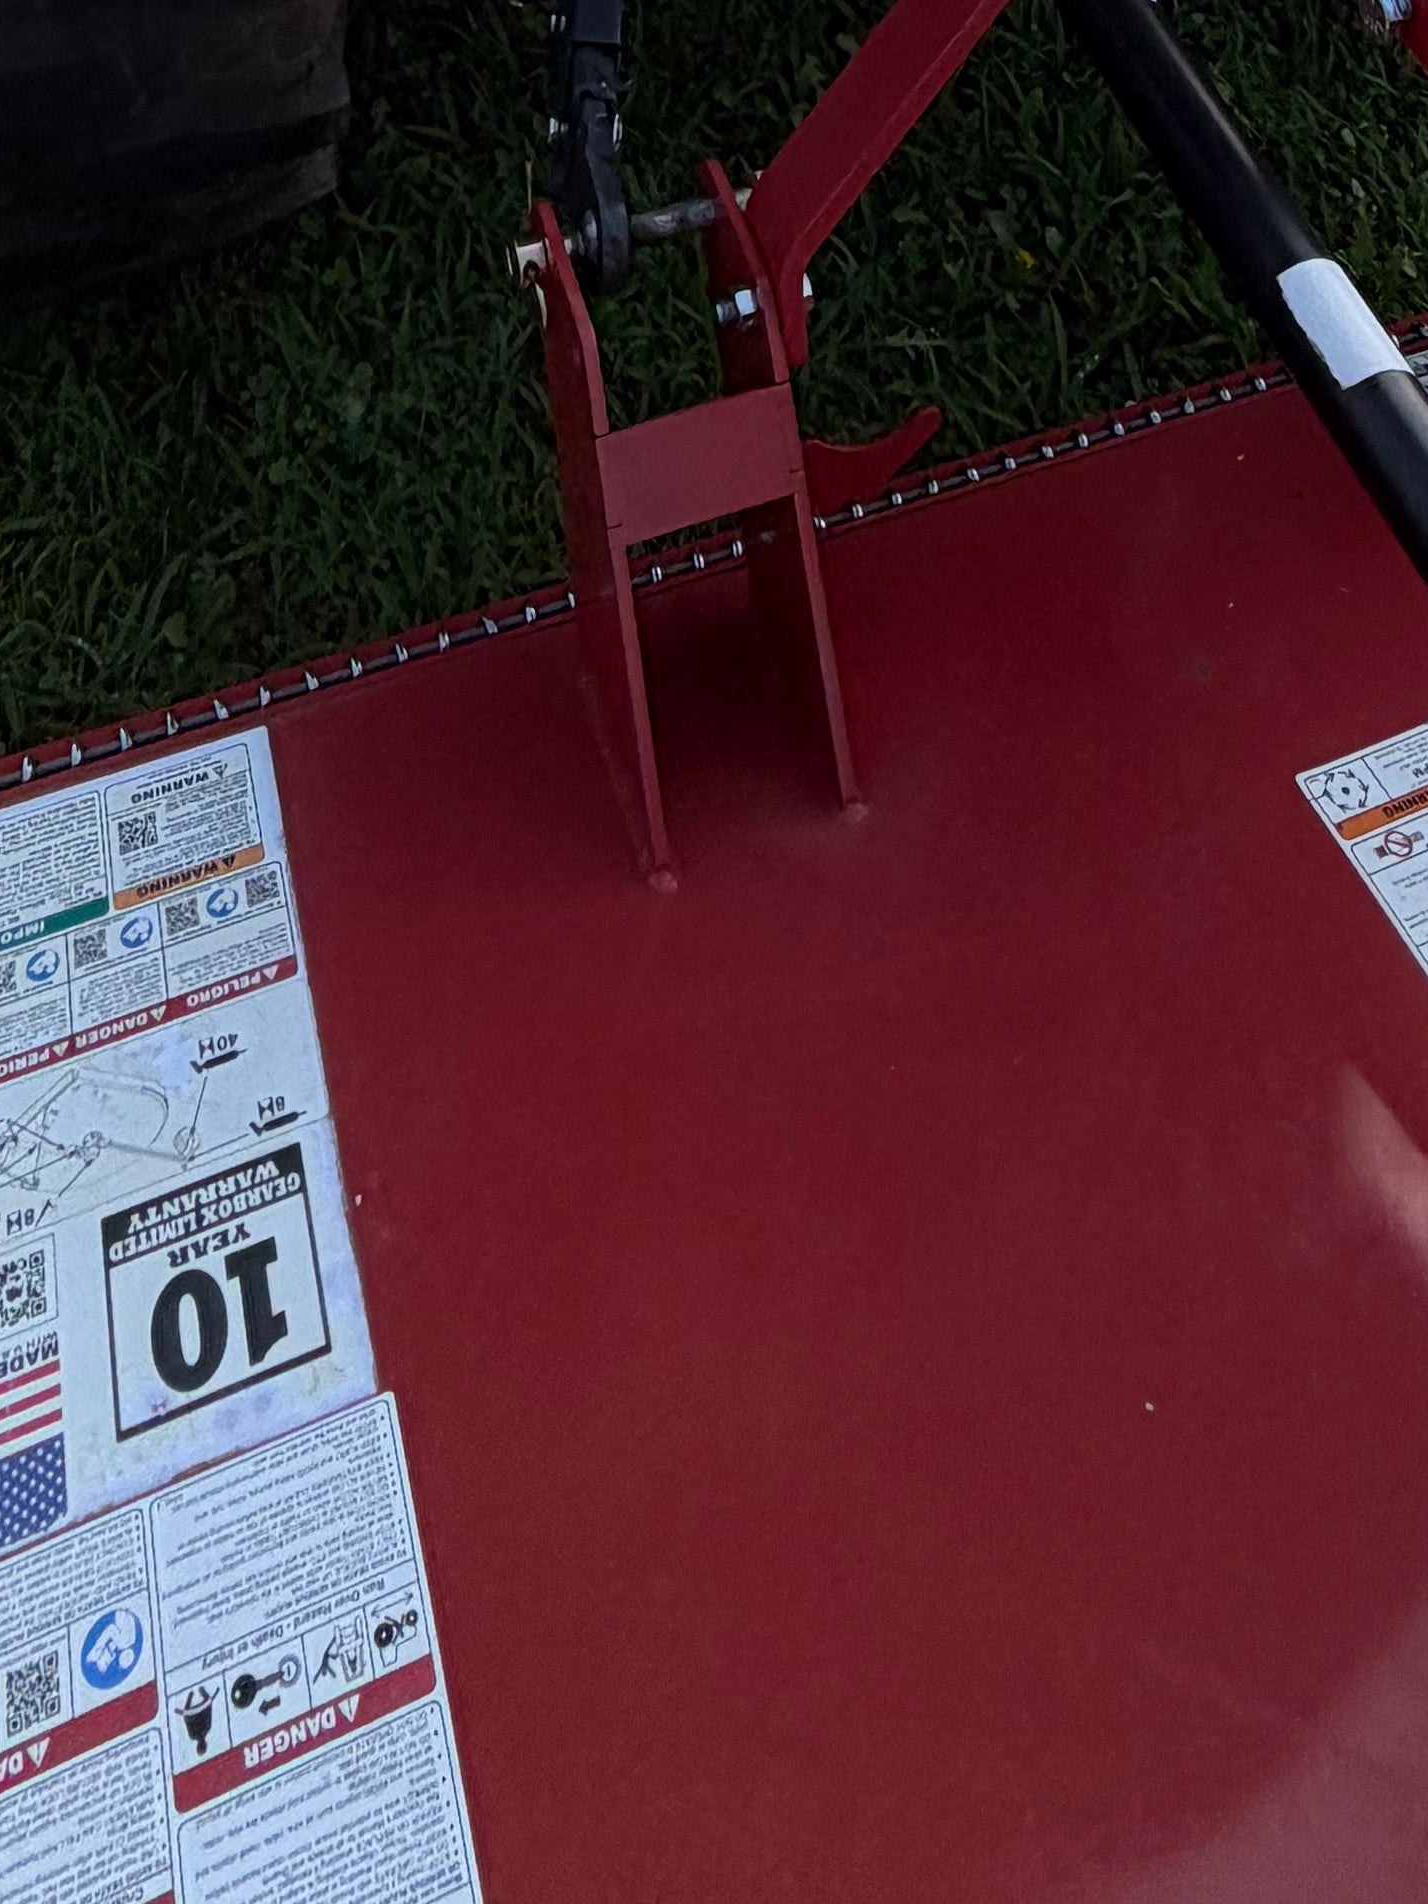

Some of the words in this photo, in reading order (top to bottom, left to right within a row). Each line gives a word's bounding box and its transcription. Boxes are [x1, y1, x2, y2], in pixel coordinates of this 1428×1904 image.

[129, 770, 208, 804] WARNING
[135, 860, 218, 899] WARNING
[185, 970, 261, 1009] PELIGRO
[75, 1011, 147, 1049] DANGER
[216, 1028, 238, 1051] 40
[125, 1157, 279, 1233] WARRANTY
[199, 1169, 301, 1227] GEARBOX
[24, 1208, 35, 1226] 8
[108, 1211, 198, 1264] LIMITED
[167, 1220, 250, 1269] YEAR
[146, 1235, 290, 1406] 10
[333, 1588, 360, 1609] Over
[201, 1645, 234, 1670] Injury
[243, 1704, 336, 1769] DANGER
